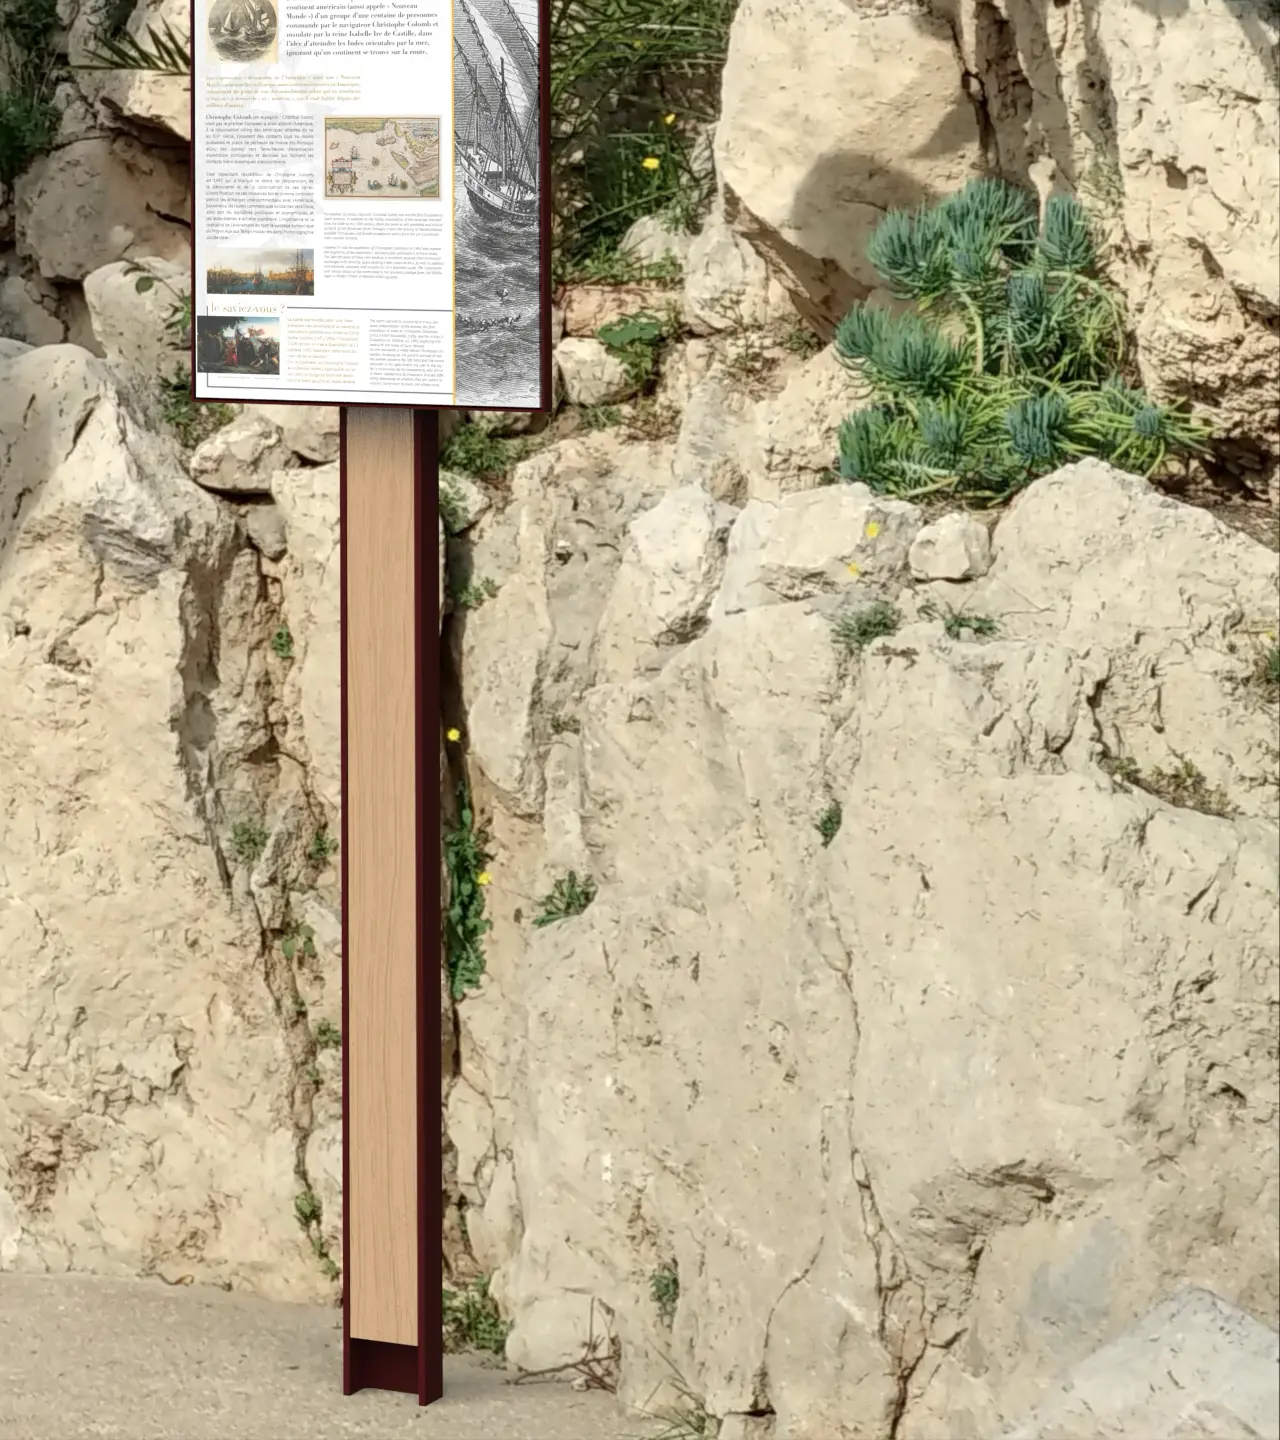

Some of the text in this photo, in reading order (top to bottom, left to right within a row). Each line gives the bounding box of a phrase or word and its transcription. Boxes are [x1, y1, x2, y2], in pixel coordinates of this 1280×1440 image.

[339, 22, 370, 30] navigateur
[373, 21, 405, 30] Christophe
[286, 50, 312, 58] ignorant
[211, 302, 286, 314] le saviez-vous ?
